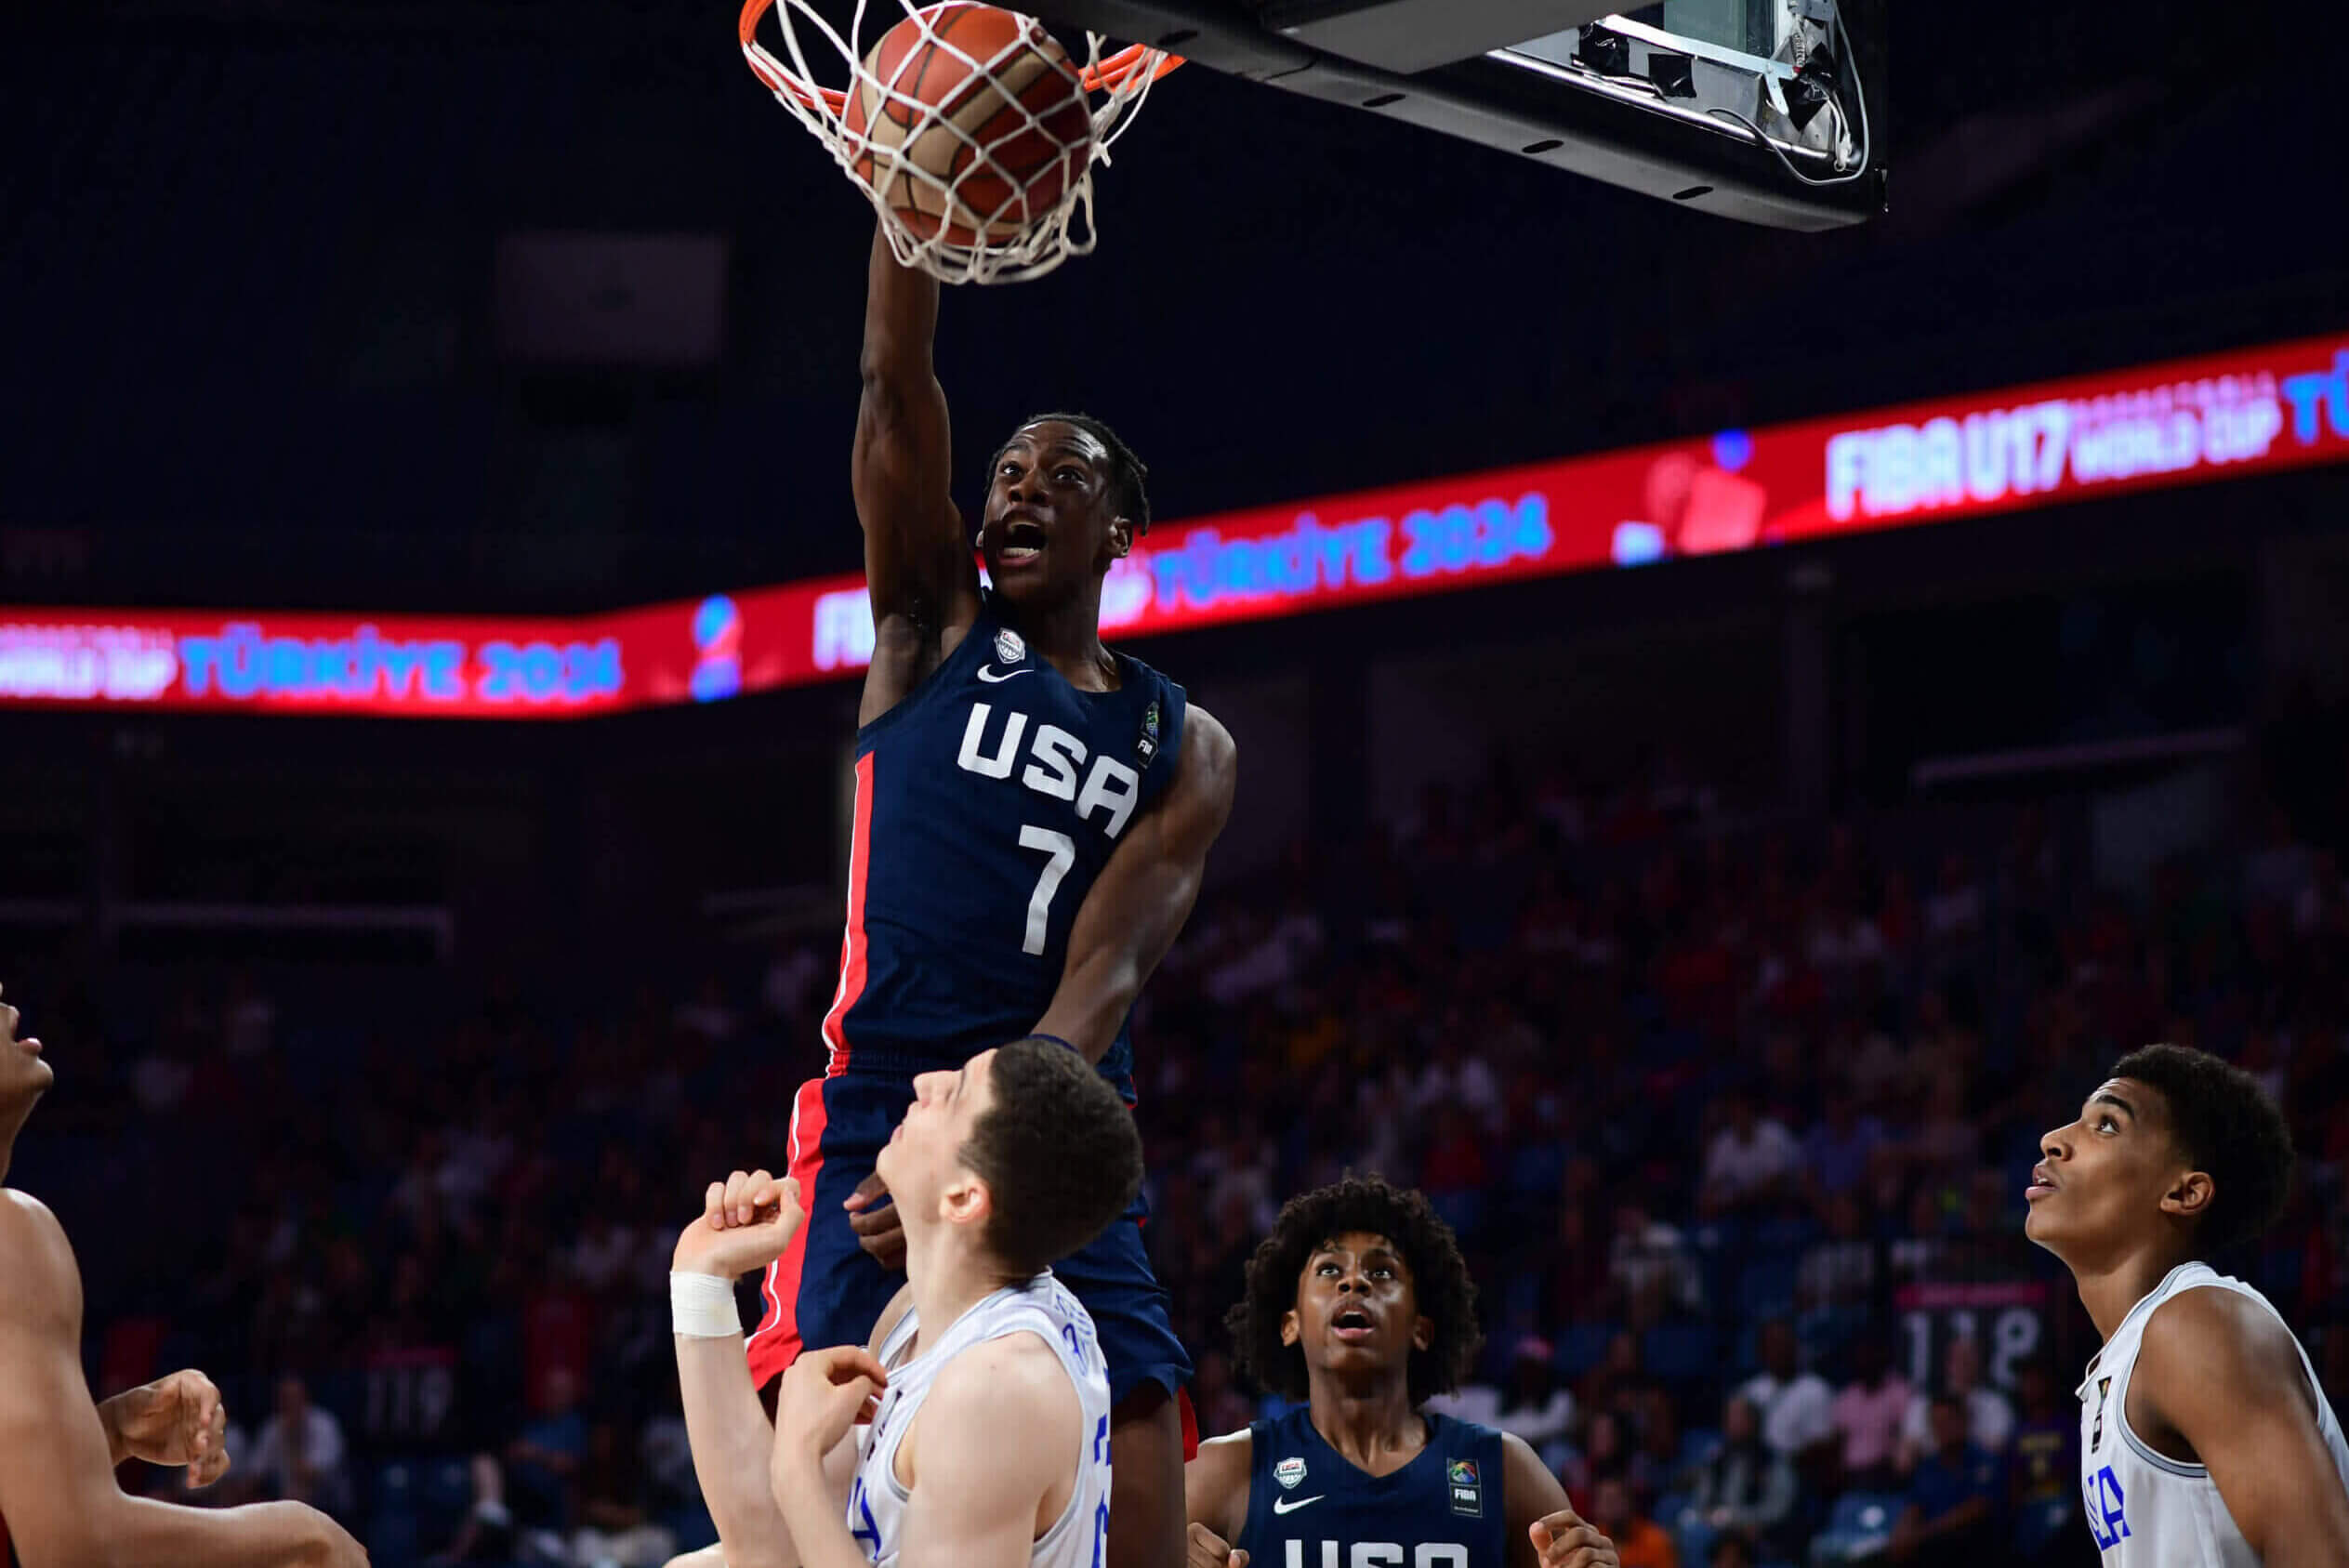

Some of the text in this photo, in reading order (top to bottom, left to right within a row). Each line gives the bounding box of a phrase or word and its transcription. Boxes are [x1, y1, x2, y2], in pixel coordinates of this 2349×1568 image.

[1827, 416, 1963, 522] FIBA
[1964, 399, 2069, 503] U17
[957, 702, 1139, 839] USA
[1019, 824, 1076, 955] 7
